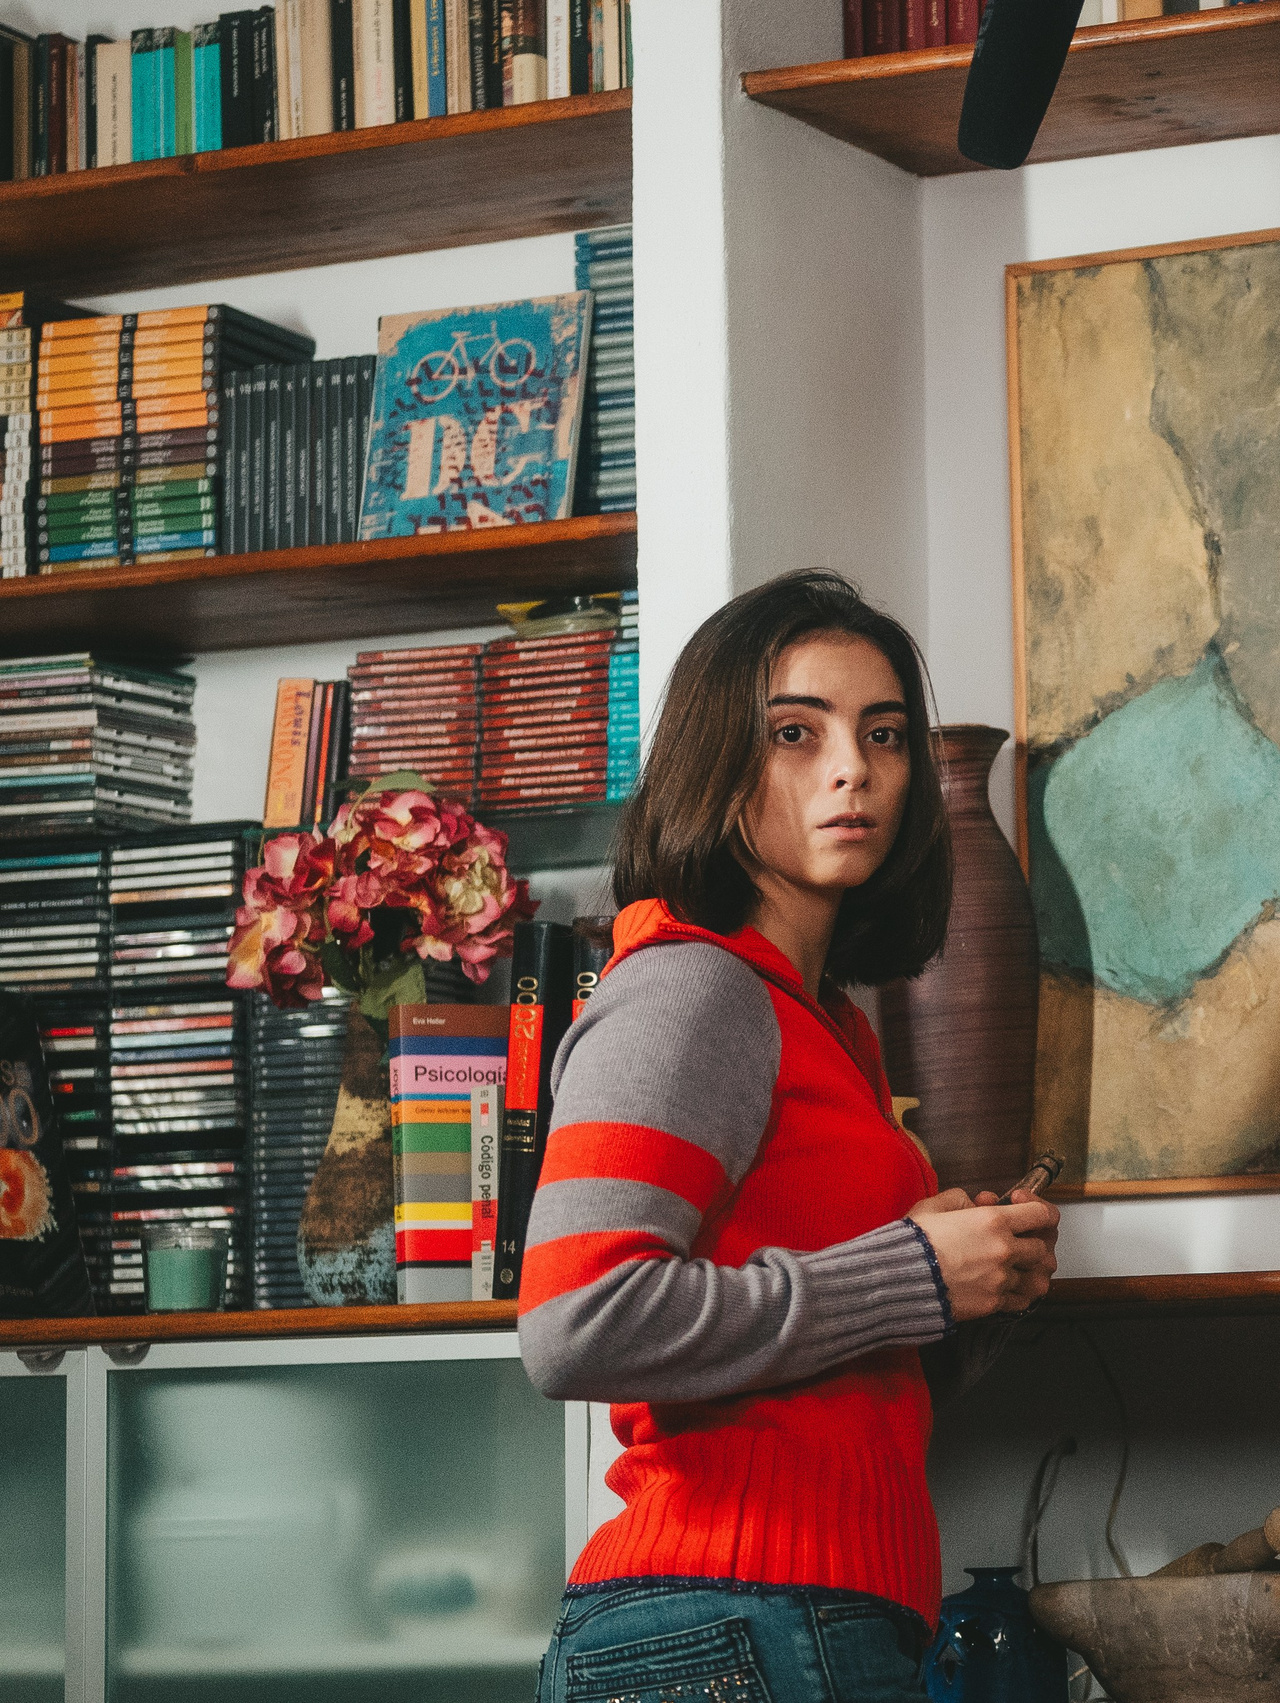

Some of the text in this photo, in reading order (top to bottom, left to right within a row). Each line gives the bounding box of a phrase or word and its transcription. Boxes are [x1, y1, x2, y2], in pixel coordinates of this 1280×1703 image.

[515, 976, 538, 1040] 2000
[478, 1135, 494, 1219] Código penal
[502, 1239, 516, 1254] 14
